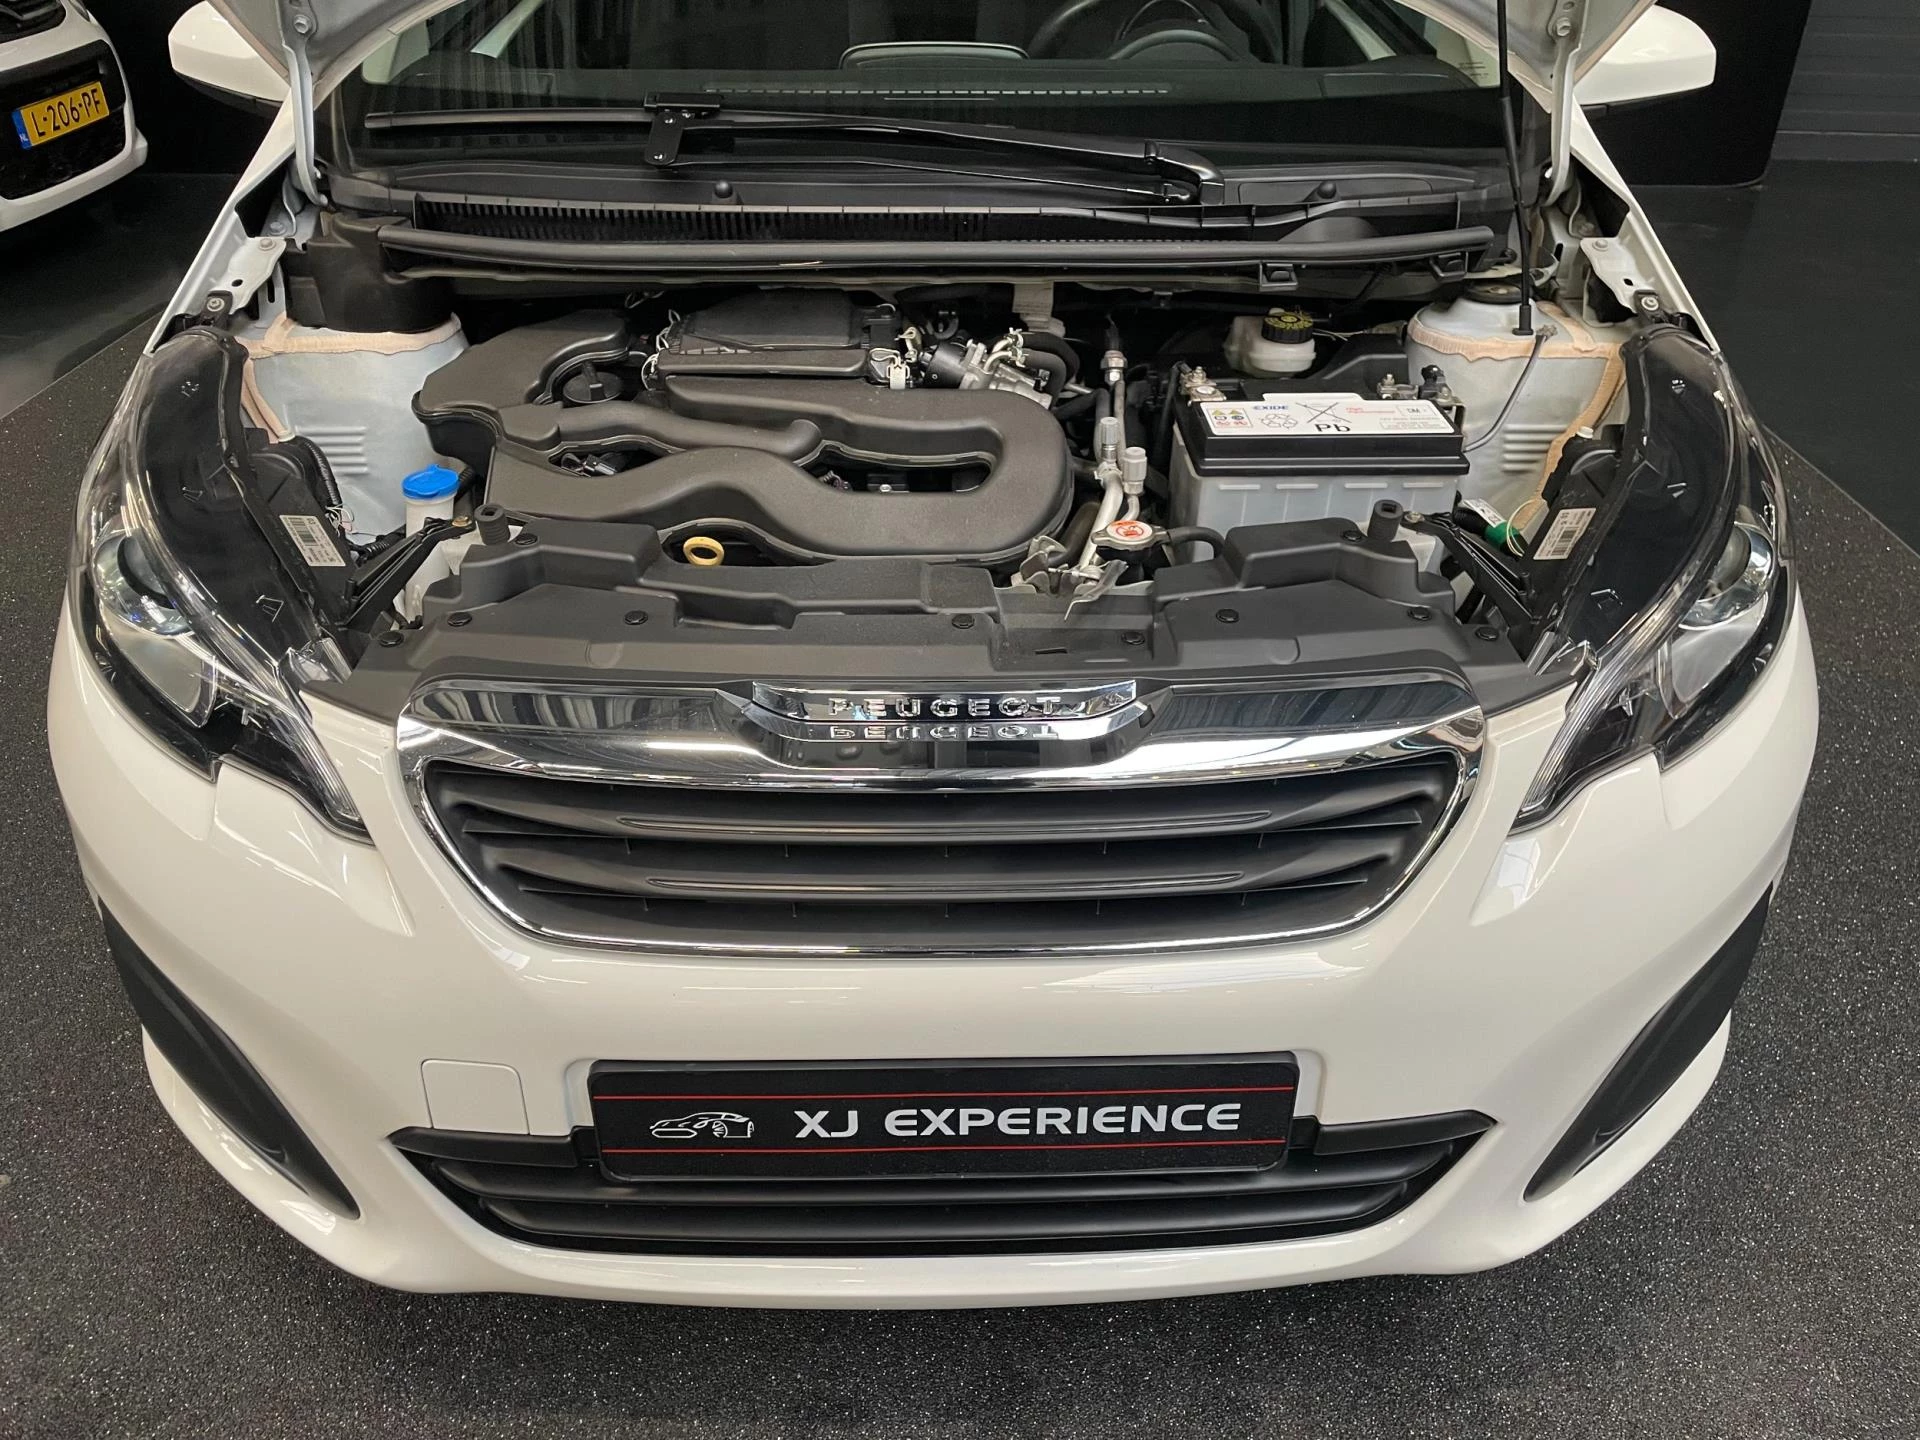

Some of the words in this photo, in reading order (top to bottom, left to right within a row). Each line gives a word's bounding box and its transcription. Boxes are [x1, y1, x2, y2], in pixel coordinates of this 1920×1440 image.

[1315, 423, 1351, 432] Pb
[828, 696, 1061, 718] PEUGEOT
[794, 1110, 859, 1139] XJ
[884, 1102, 1242, 1137] EXPERIENCE
